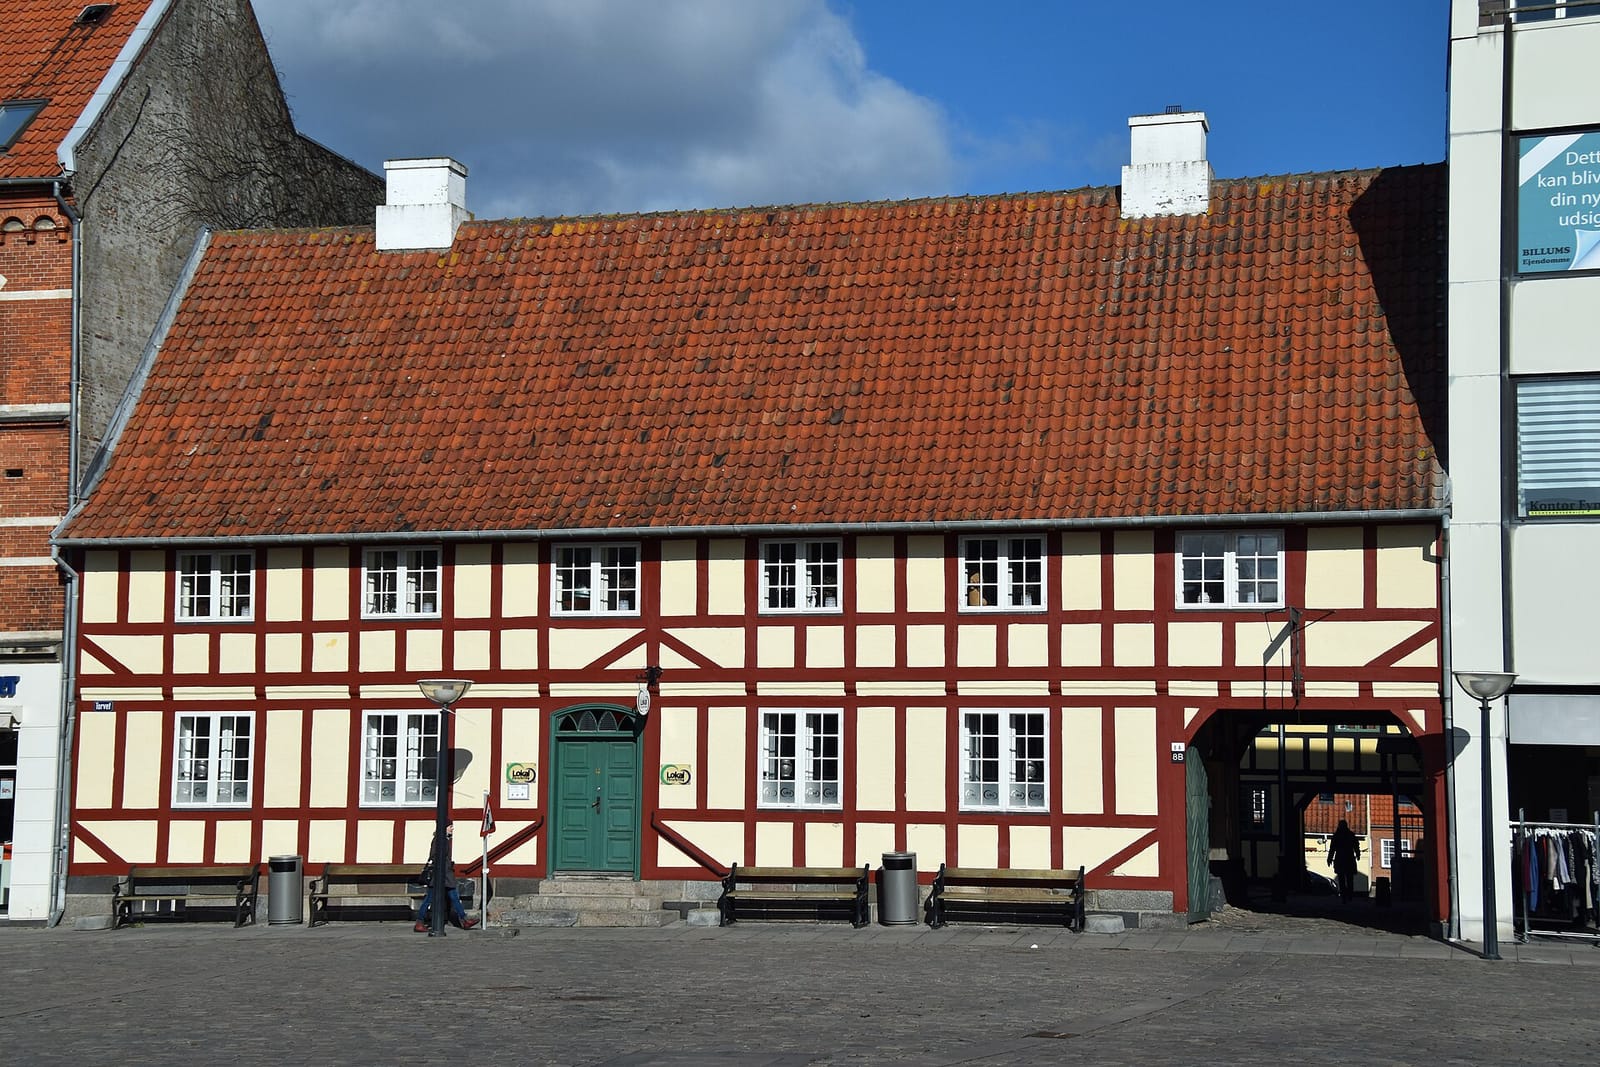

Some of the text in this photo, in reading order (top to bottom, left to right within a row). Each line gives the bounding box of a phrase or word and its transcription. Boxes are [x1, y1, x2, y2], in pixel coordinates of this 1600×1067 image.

[1538, 174, 1567, 188] kan
[1550, 193, 1577, 207] din
[1522, 246, 1571, 257] BILLUMS
[1522, 256, 1571, 266] Ejendomme
[1529, 500, 1576, 511] Kontor
[512, 769, 531, 777] Lokal
[666, 771, 685, 779] Lokal
